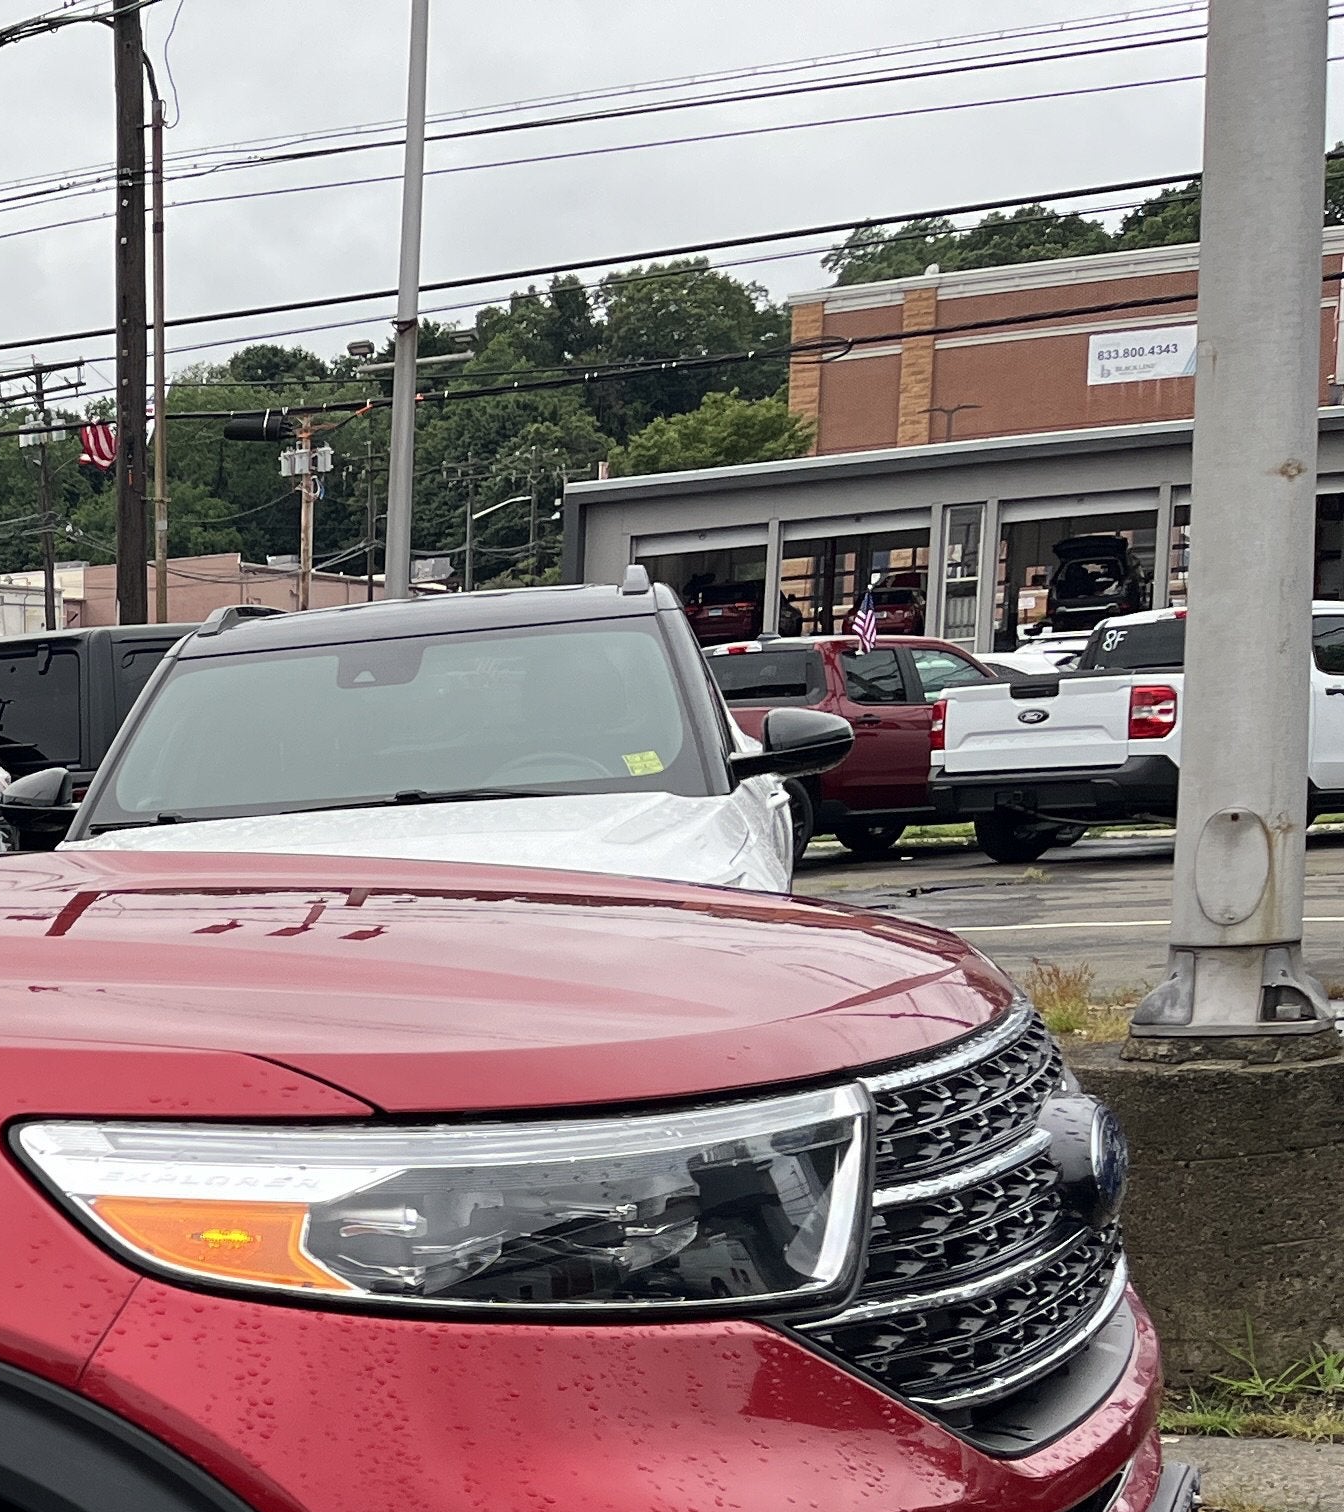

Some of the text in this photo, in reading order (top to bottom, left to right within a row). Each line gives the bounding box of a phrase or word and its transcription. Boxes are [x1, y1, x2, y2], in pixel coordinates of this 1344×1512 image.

[1097, 343, 1177, 360] 833.800.4343
[1102, 629, 1128, 652] 8F
[98, 1170, 321, 1189] EXPLORER
